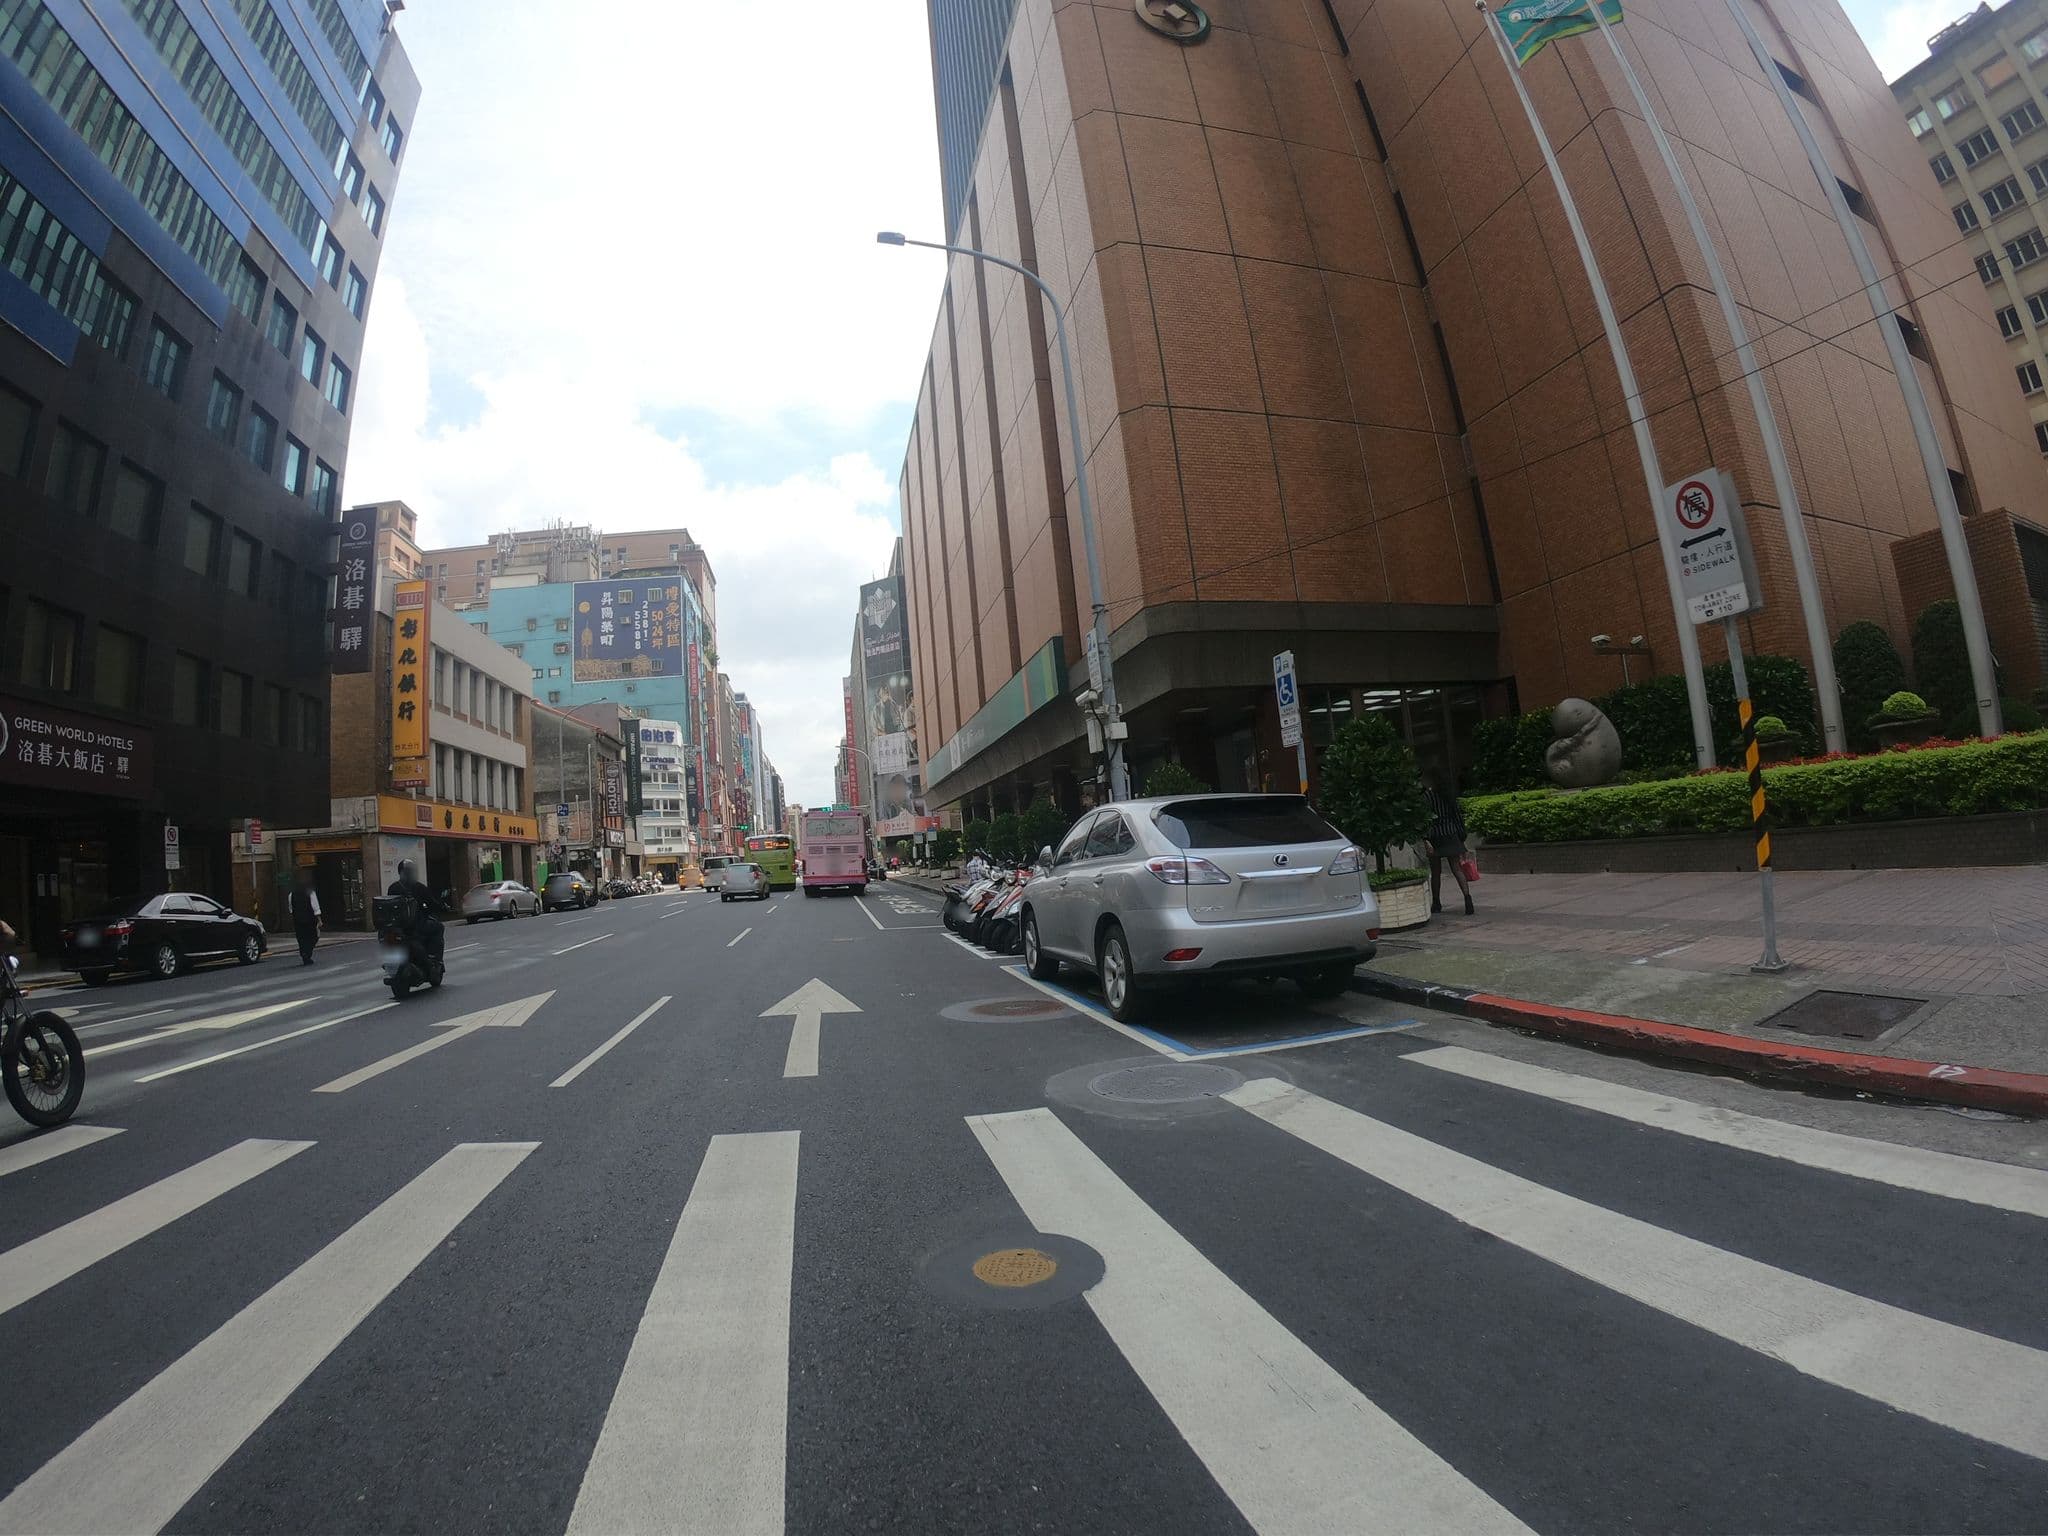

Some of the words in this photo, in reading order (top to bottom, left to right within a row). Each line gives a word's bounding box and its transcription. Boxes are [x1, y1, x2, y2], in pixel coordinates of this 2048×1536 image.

[1692, 554, 1736, 574] SIDEWALK
[14, 716, 52, 735] GREEN
[55, 724, 95, 744] WORLD
[97, 734, 134, 751] HOTELS
[607, 778, 618, 814] NOTCH
